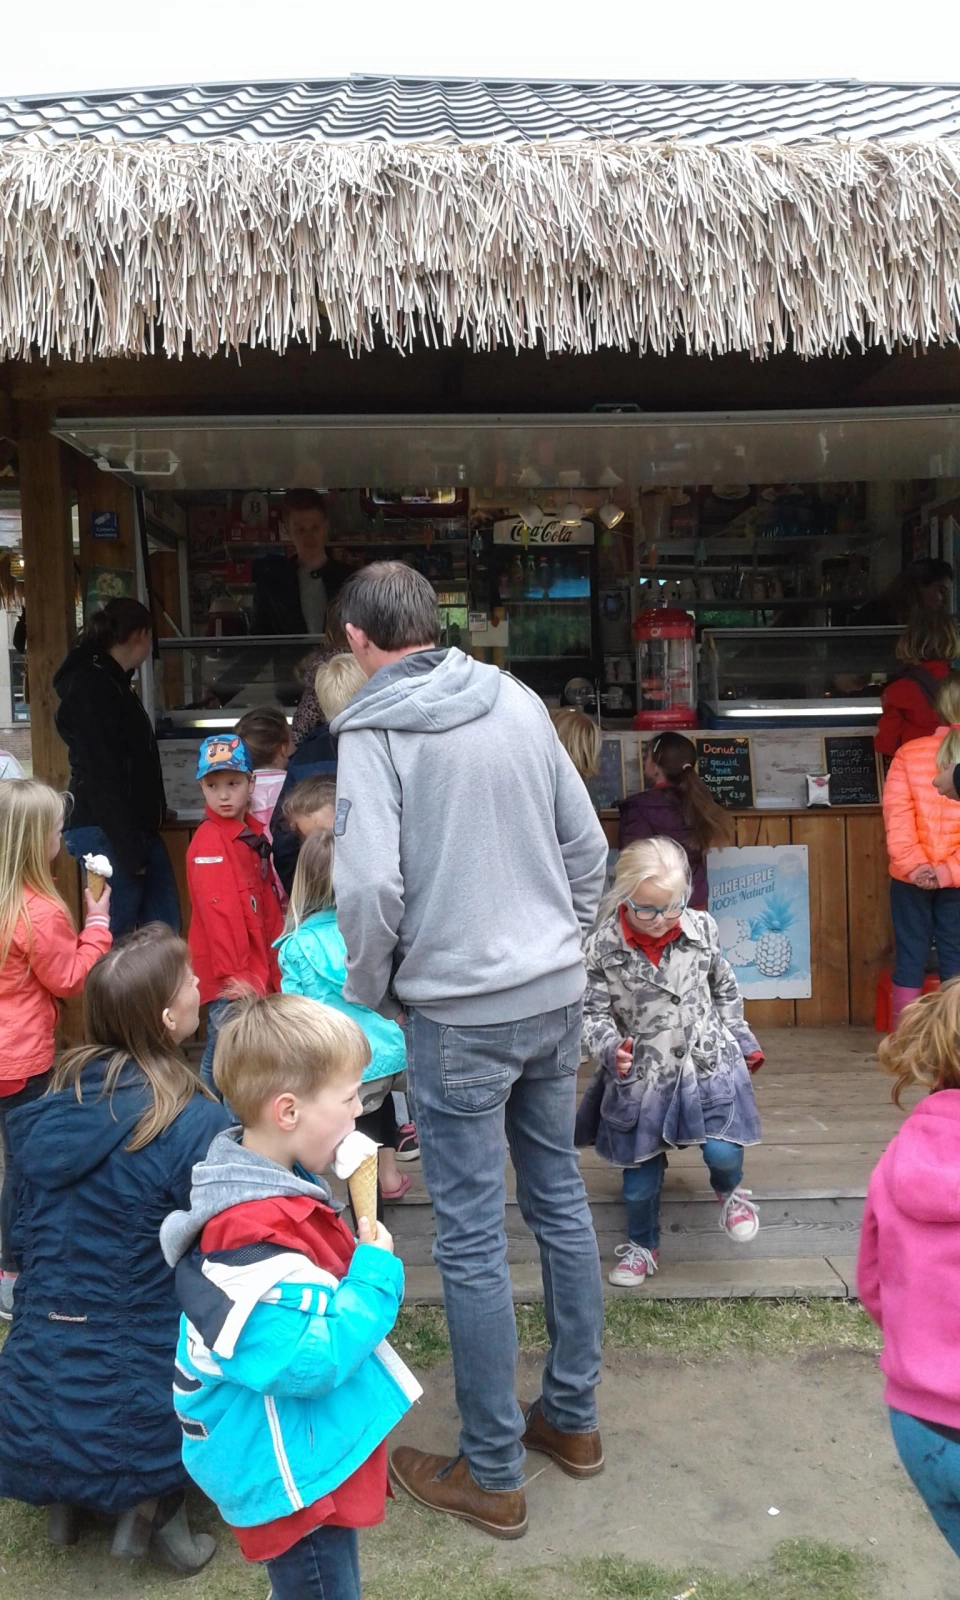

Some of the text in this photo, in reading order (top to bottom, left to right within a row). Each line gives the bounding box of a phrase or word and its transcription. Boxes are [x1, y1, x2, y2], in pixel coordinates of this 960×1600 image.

[703, 743, 735, 754] Donut
[830, 749, 863, 758] mango
[831, 755, 861, 766] smurf
[831, 766, 870, 775] Banaan
[712, 867, 775, 898] PINEAPPLE
[711, 882, 776, 912] 100% Natural
